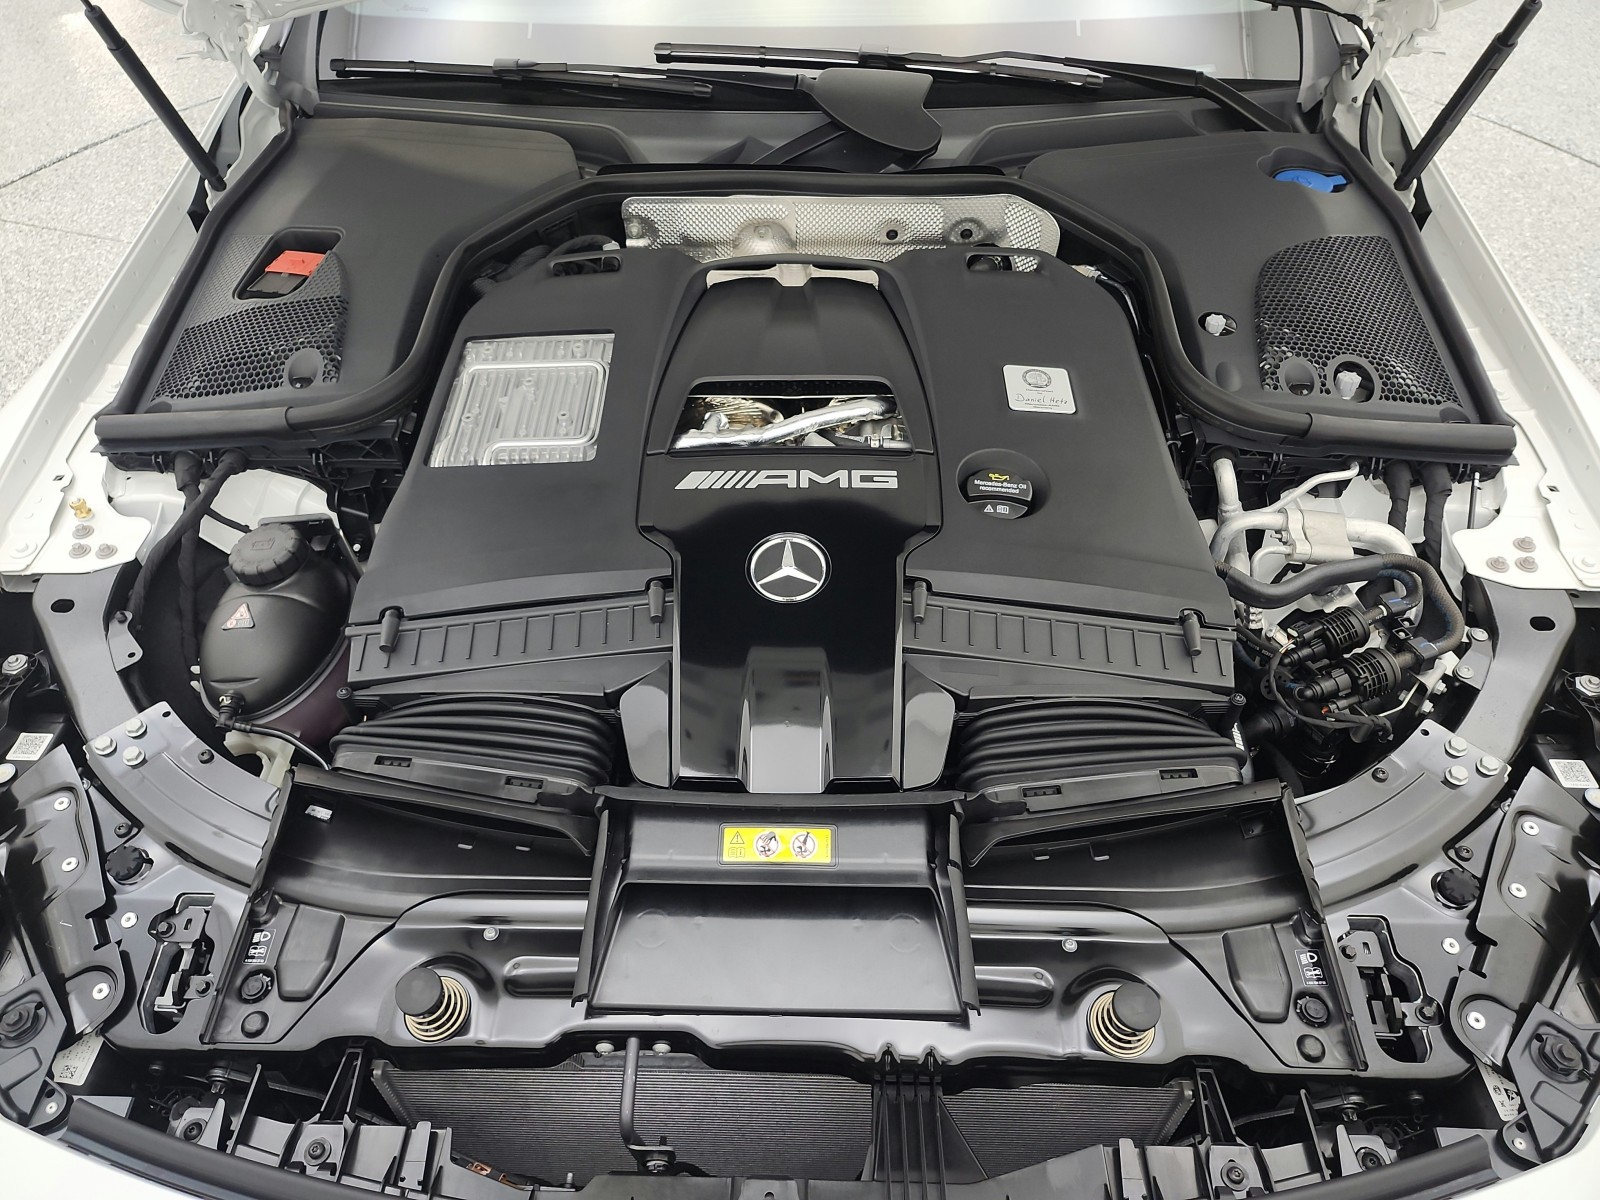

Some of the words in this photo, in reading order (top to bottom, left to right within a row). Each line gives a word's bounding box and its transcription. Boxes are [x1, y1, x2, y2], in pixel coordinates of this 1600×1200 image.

[1015, 393, 1045, 403] Daniel
[745, 469, 898, 489] AMG
[974, 479, 1017, 488] Mercedes-Benz
[979, 485, 1019, 493] recommended
